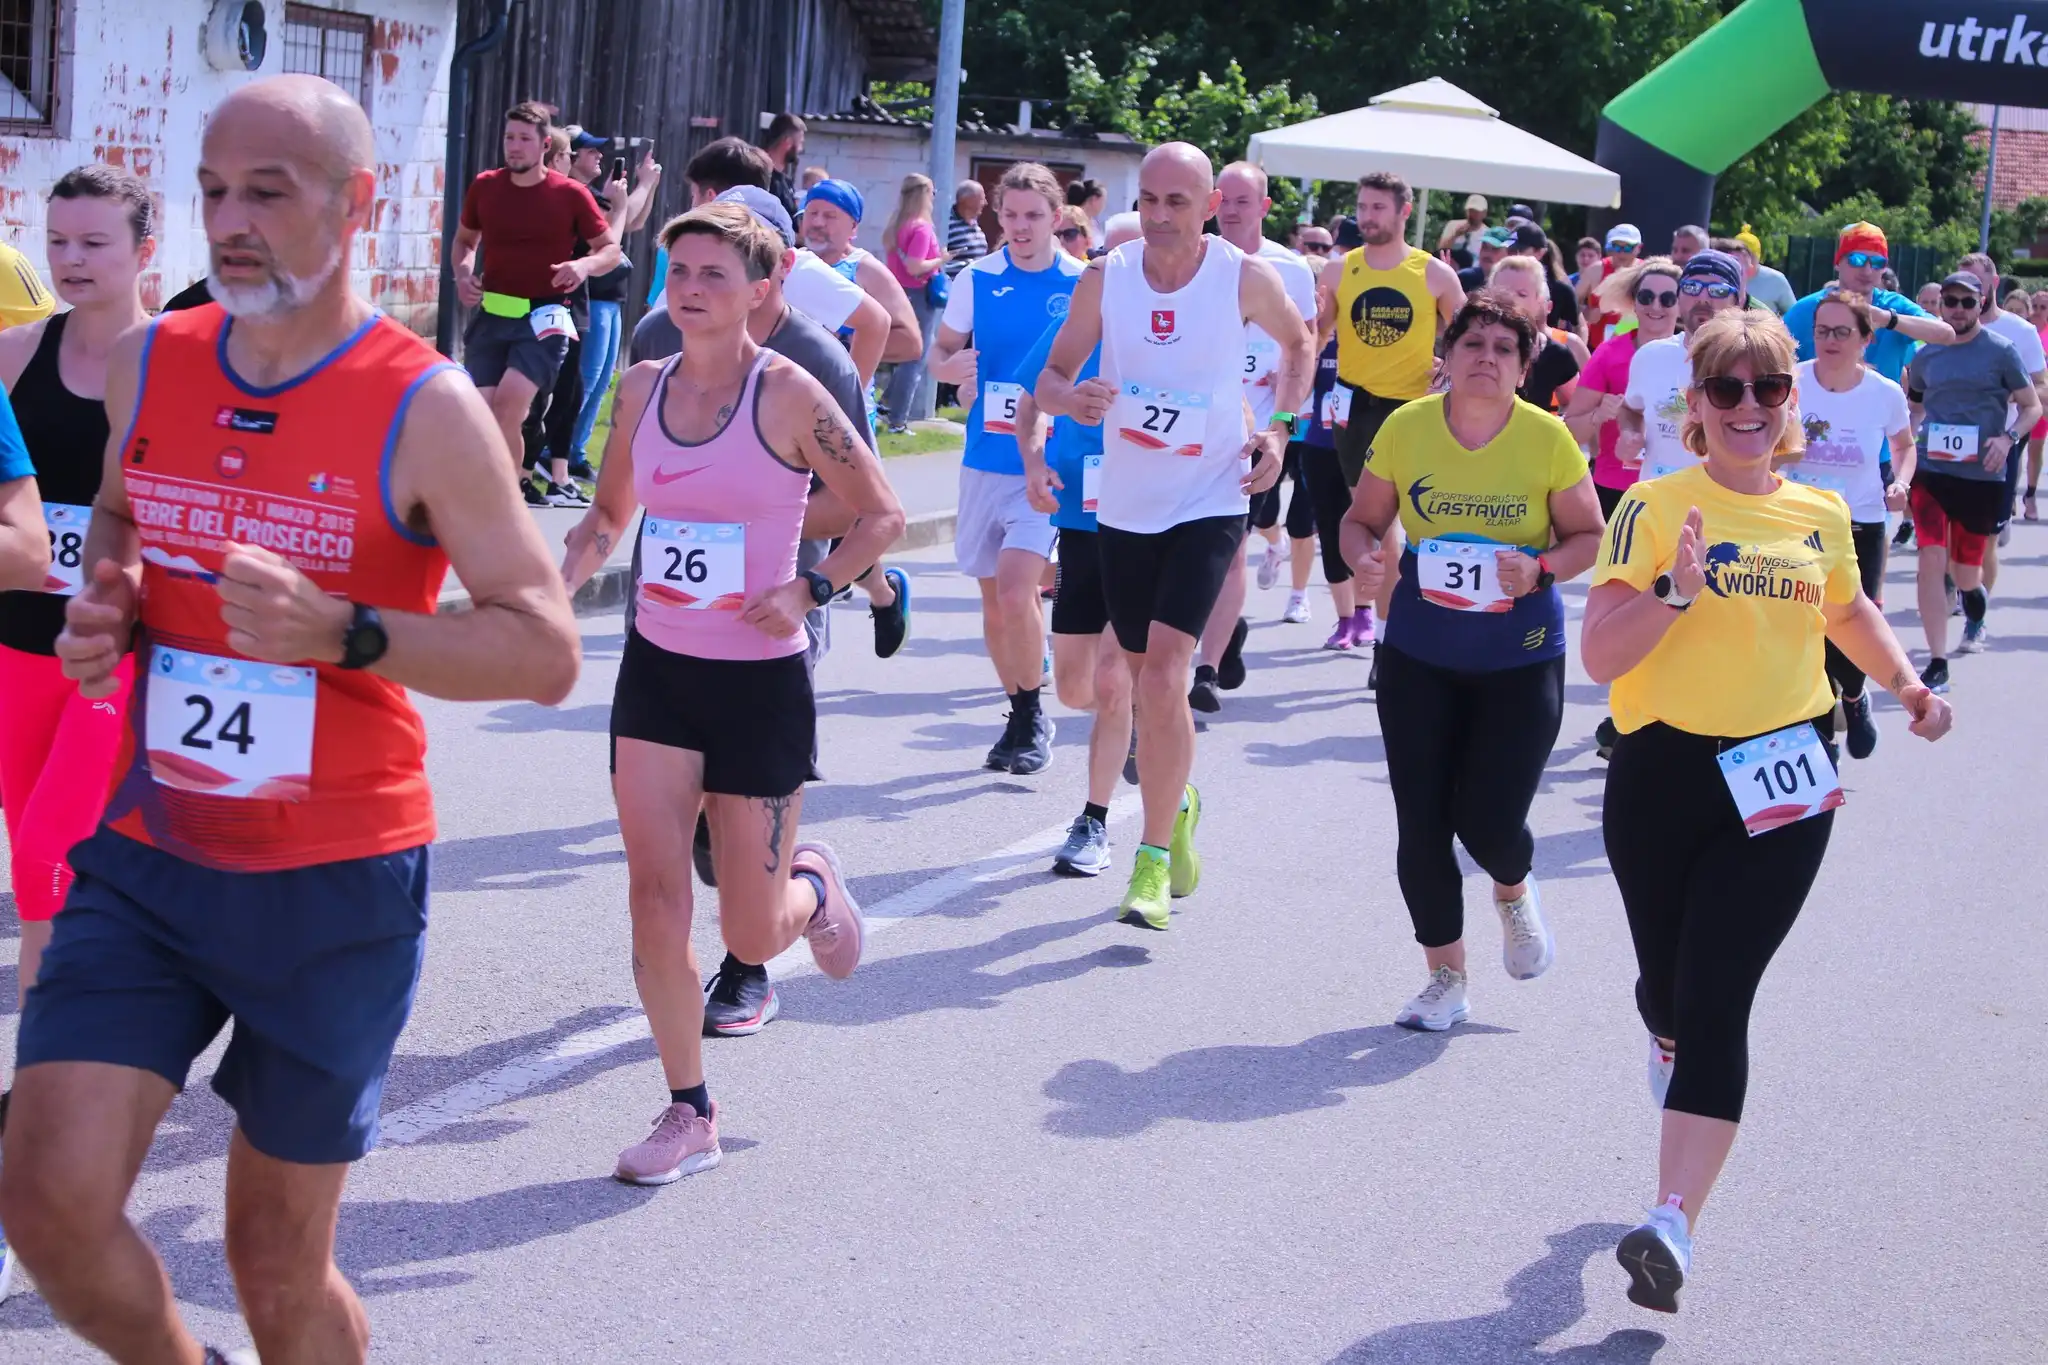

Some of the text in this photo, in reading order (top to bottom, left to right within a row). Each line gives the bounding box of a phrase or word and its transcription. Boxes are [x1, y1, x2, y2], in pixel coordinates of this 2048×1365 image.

[1004, 398, 1016, 419] 5
[1142, 405, 1180, 433] 27
[1943, 436, 1963, 450] 10
[1430, 491, 1529, 504] SPORTSKO DRUŠTVO
[1428, 501, 1528, 519] LASTAVICA
[318, 512, 355, 533] 2015
[1485, 517, 1521, 527] ZLATAR
[188, 508, 228, 537] DEL
[232, 514, 355, 560] PROSECCO
[664, 546, 708, 583] 26
[1741, 554, 1790, 568] WINGS
[1749, 564, 1777, 576] LIFE
[1445, 562, 1481, 591] 31
[1724, 572, 1793, 599] WORLD
[181, 694, 255, 754] 24
[1753, 752, 1817, 800] 101
